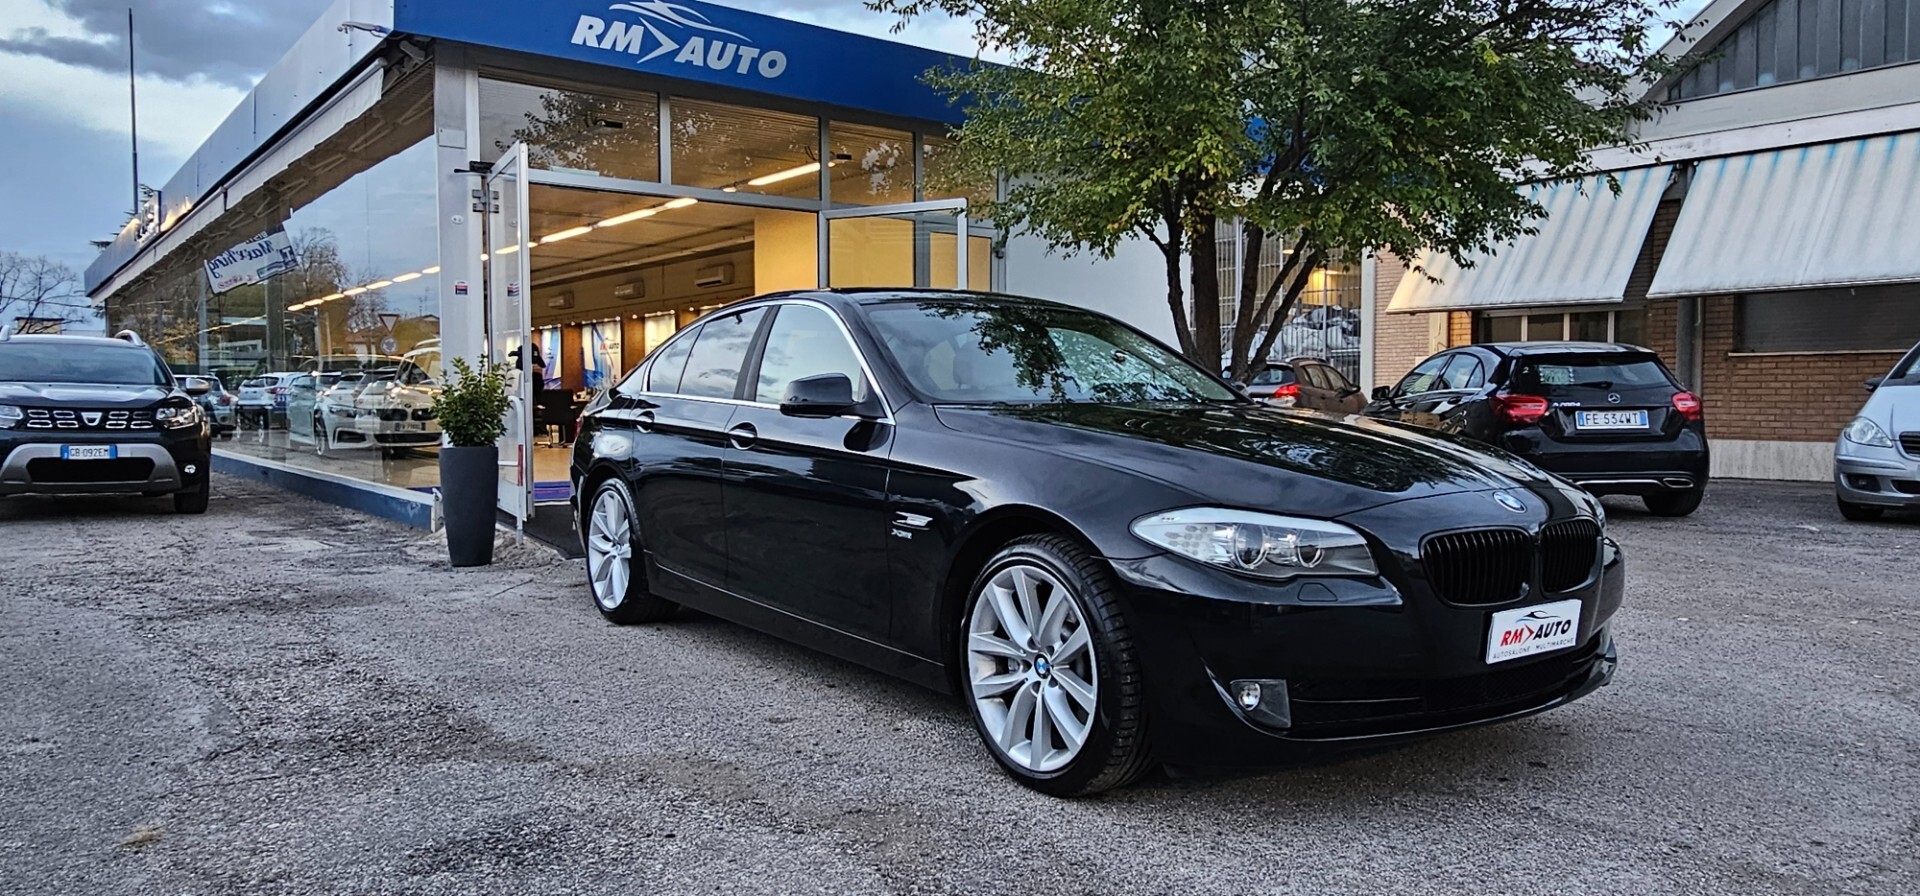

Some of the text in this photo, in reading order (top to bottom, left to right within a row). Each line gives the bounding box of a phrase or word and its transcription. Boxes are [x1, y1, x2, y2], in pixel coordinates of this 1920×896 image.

[674, 36, 788, 79] AUTO
[1585, 412, 1638, 425] FE 534WT
[1532, 619, 1572, 641] AUTO
